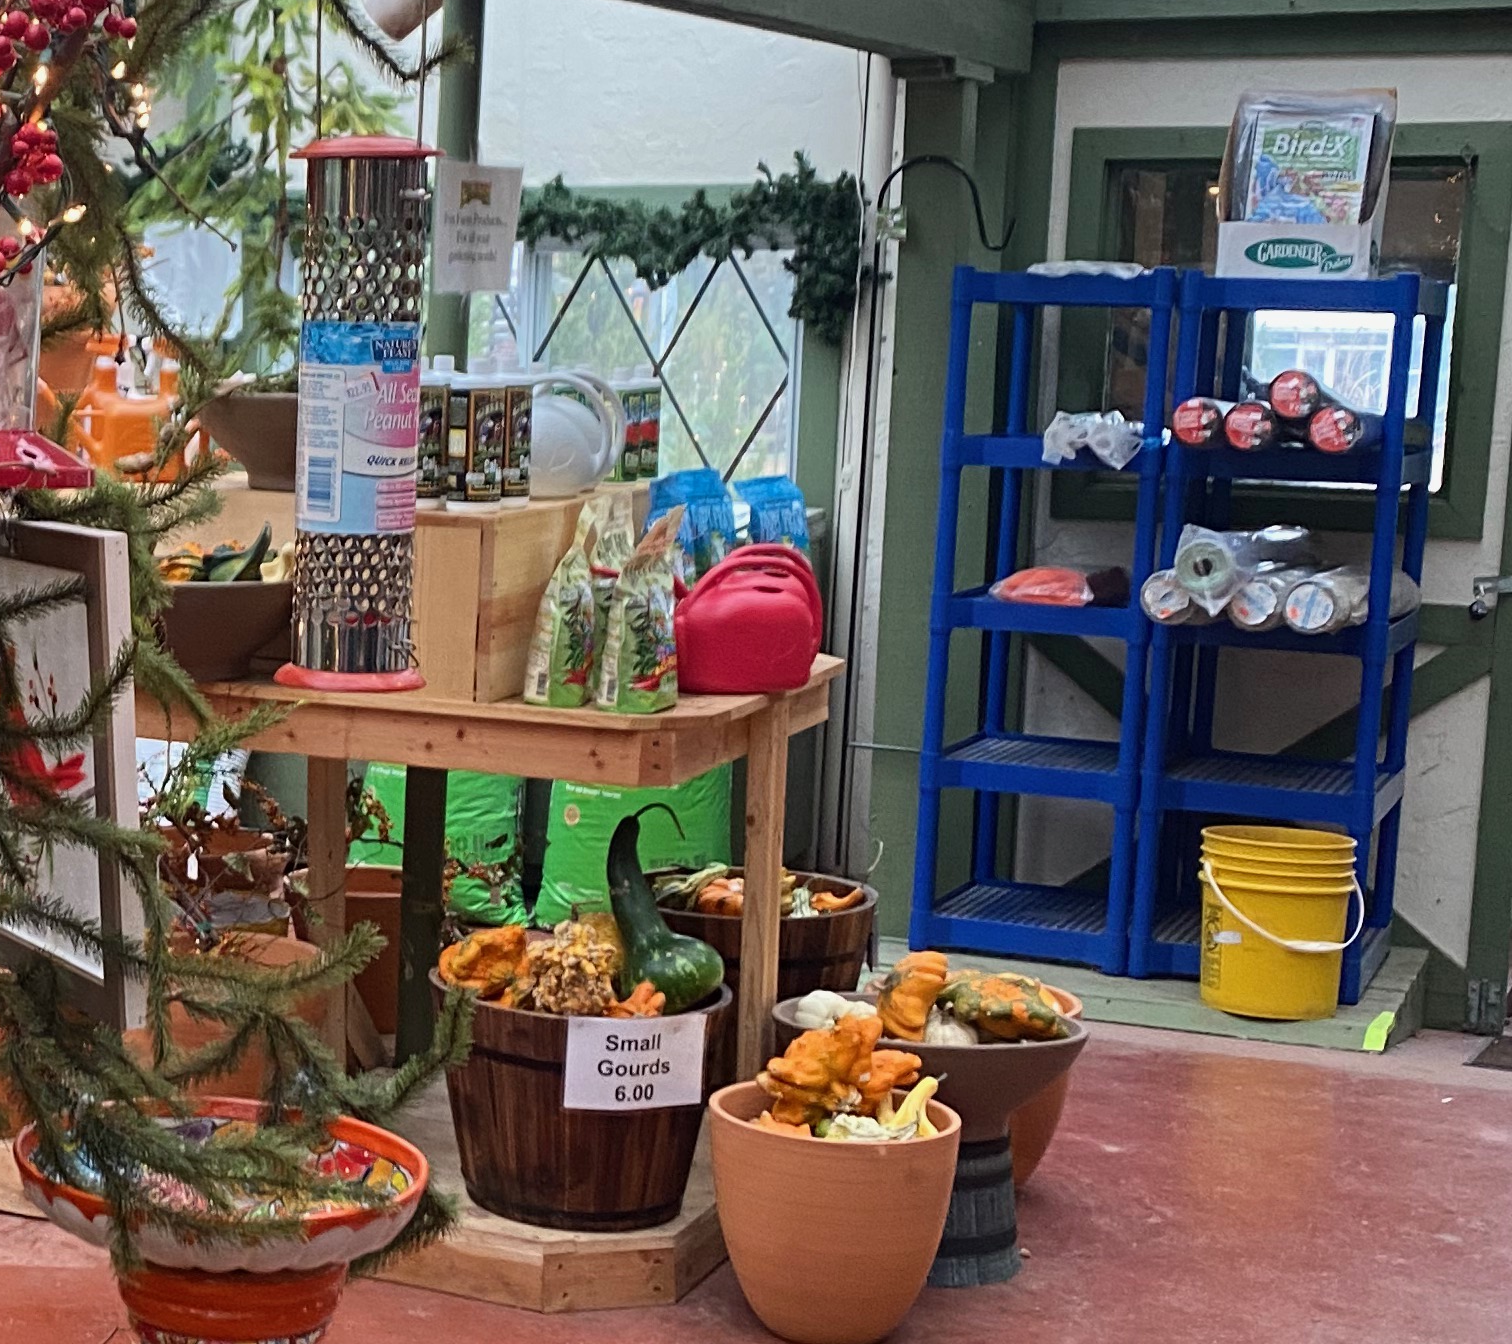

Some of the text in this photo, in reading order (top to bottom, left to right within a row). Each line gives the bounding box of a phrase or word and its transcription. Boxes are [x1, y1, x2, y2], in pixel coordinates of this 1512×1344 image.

[1272, 133, 1352, 159] Bird-X
[377, 382, 420, 405] All Sea
[364, 408, 413, 432] Peanut
[367, 455, 396, 466] QUICK
[605, 1033, 661, 1052] Small
[597, 1058, 671, 1077] Gourds
[614, 1083, 655, 1102] 6.00
